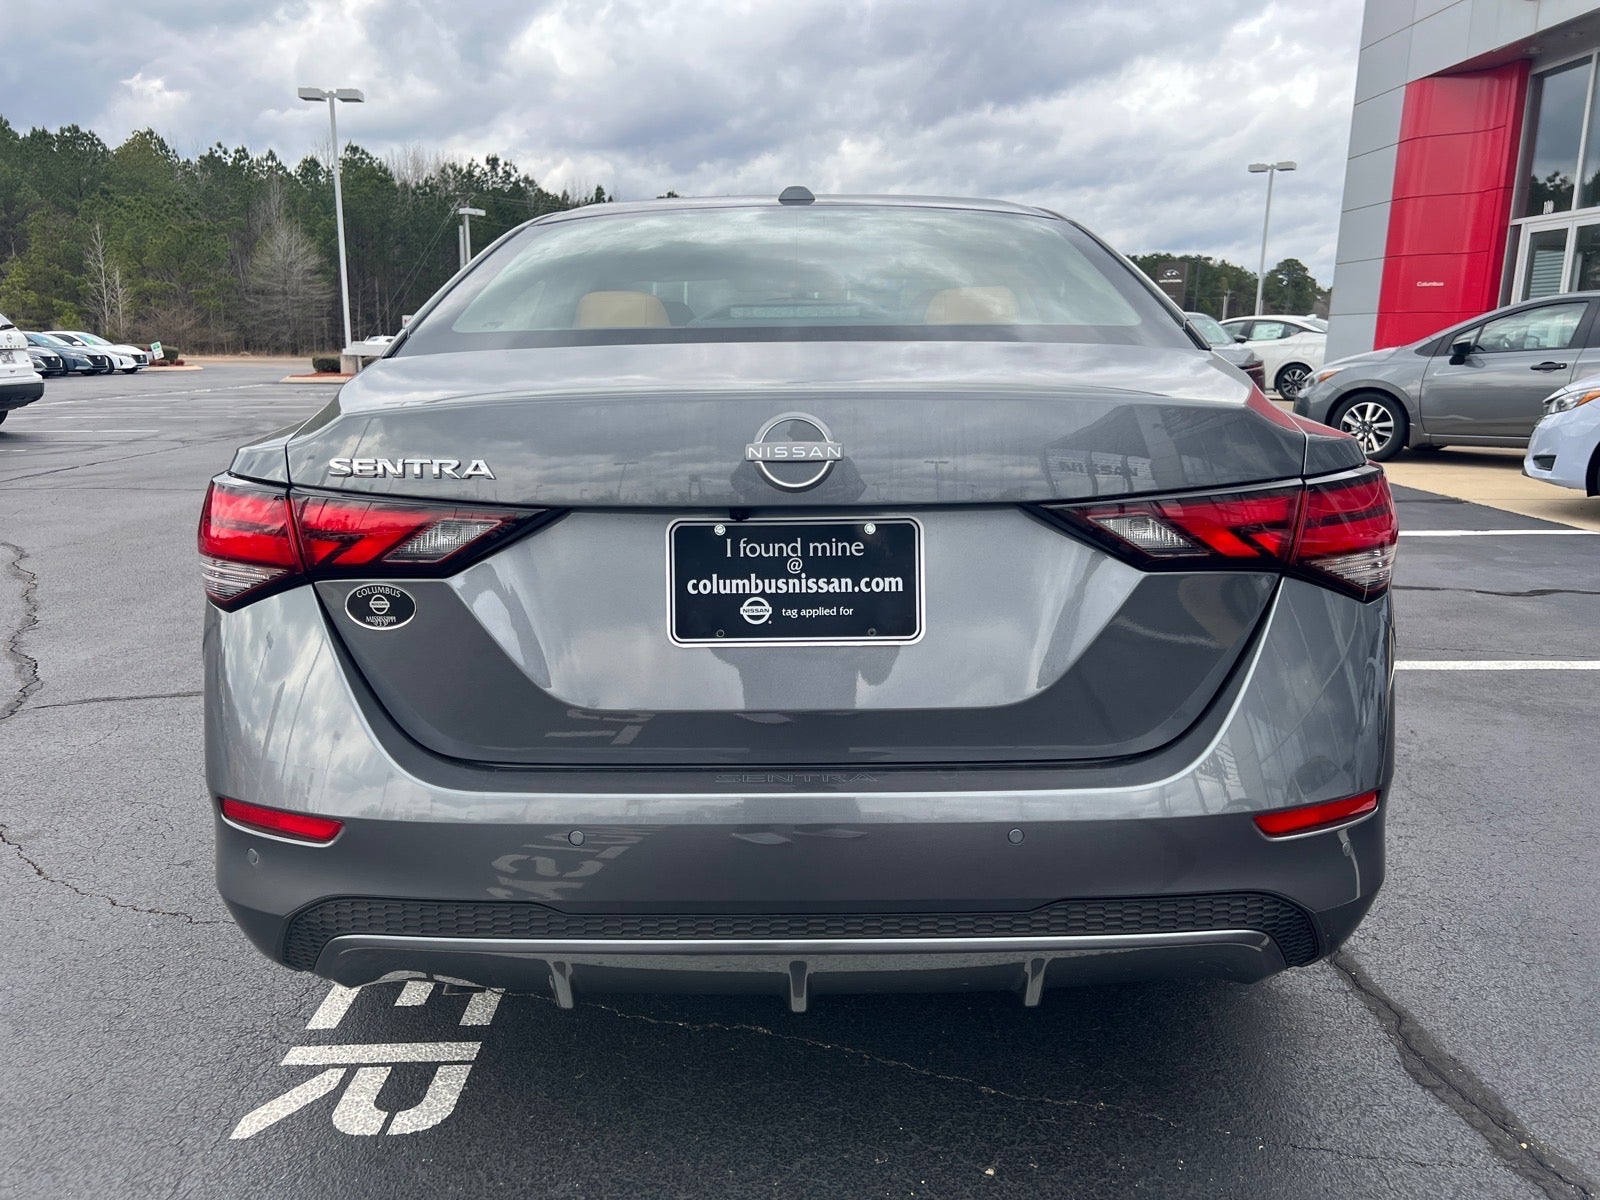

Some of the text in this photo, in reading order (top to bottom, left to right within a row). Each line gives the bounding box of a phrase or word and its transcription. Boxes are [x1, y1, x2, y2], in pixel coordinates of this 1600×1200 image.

[748, 446, 841, 458] NISSAN
[328, 457, 496, 480] SENTRA
[726, 537, 865, 558] I found mine
[786, 557, 803, 574] @
[686, 573, 904, 595] columbusnissan.com
[356, 586, 401, 598] COLUMBUS
[781, 606, 854, 619] tag applied for
[715, 773, 879, 783] SENTRA
